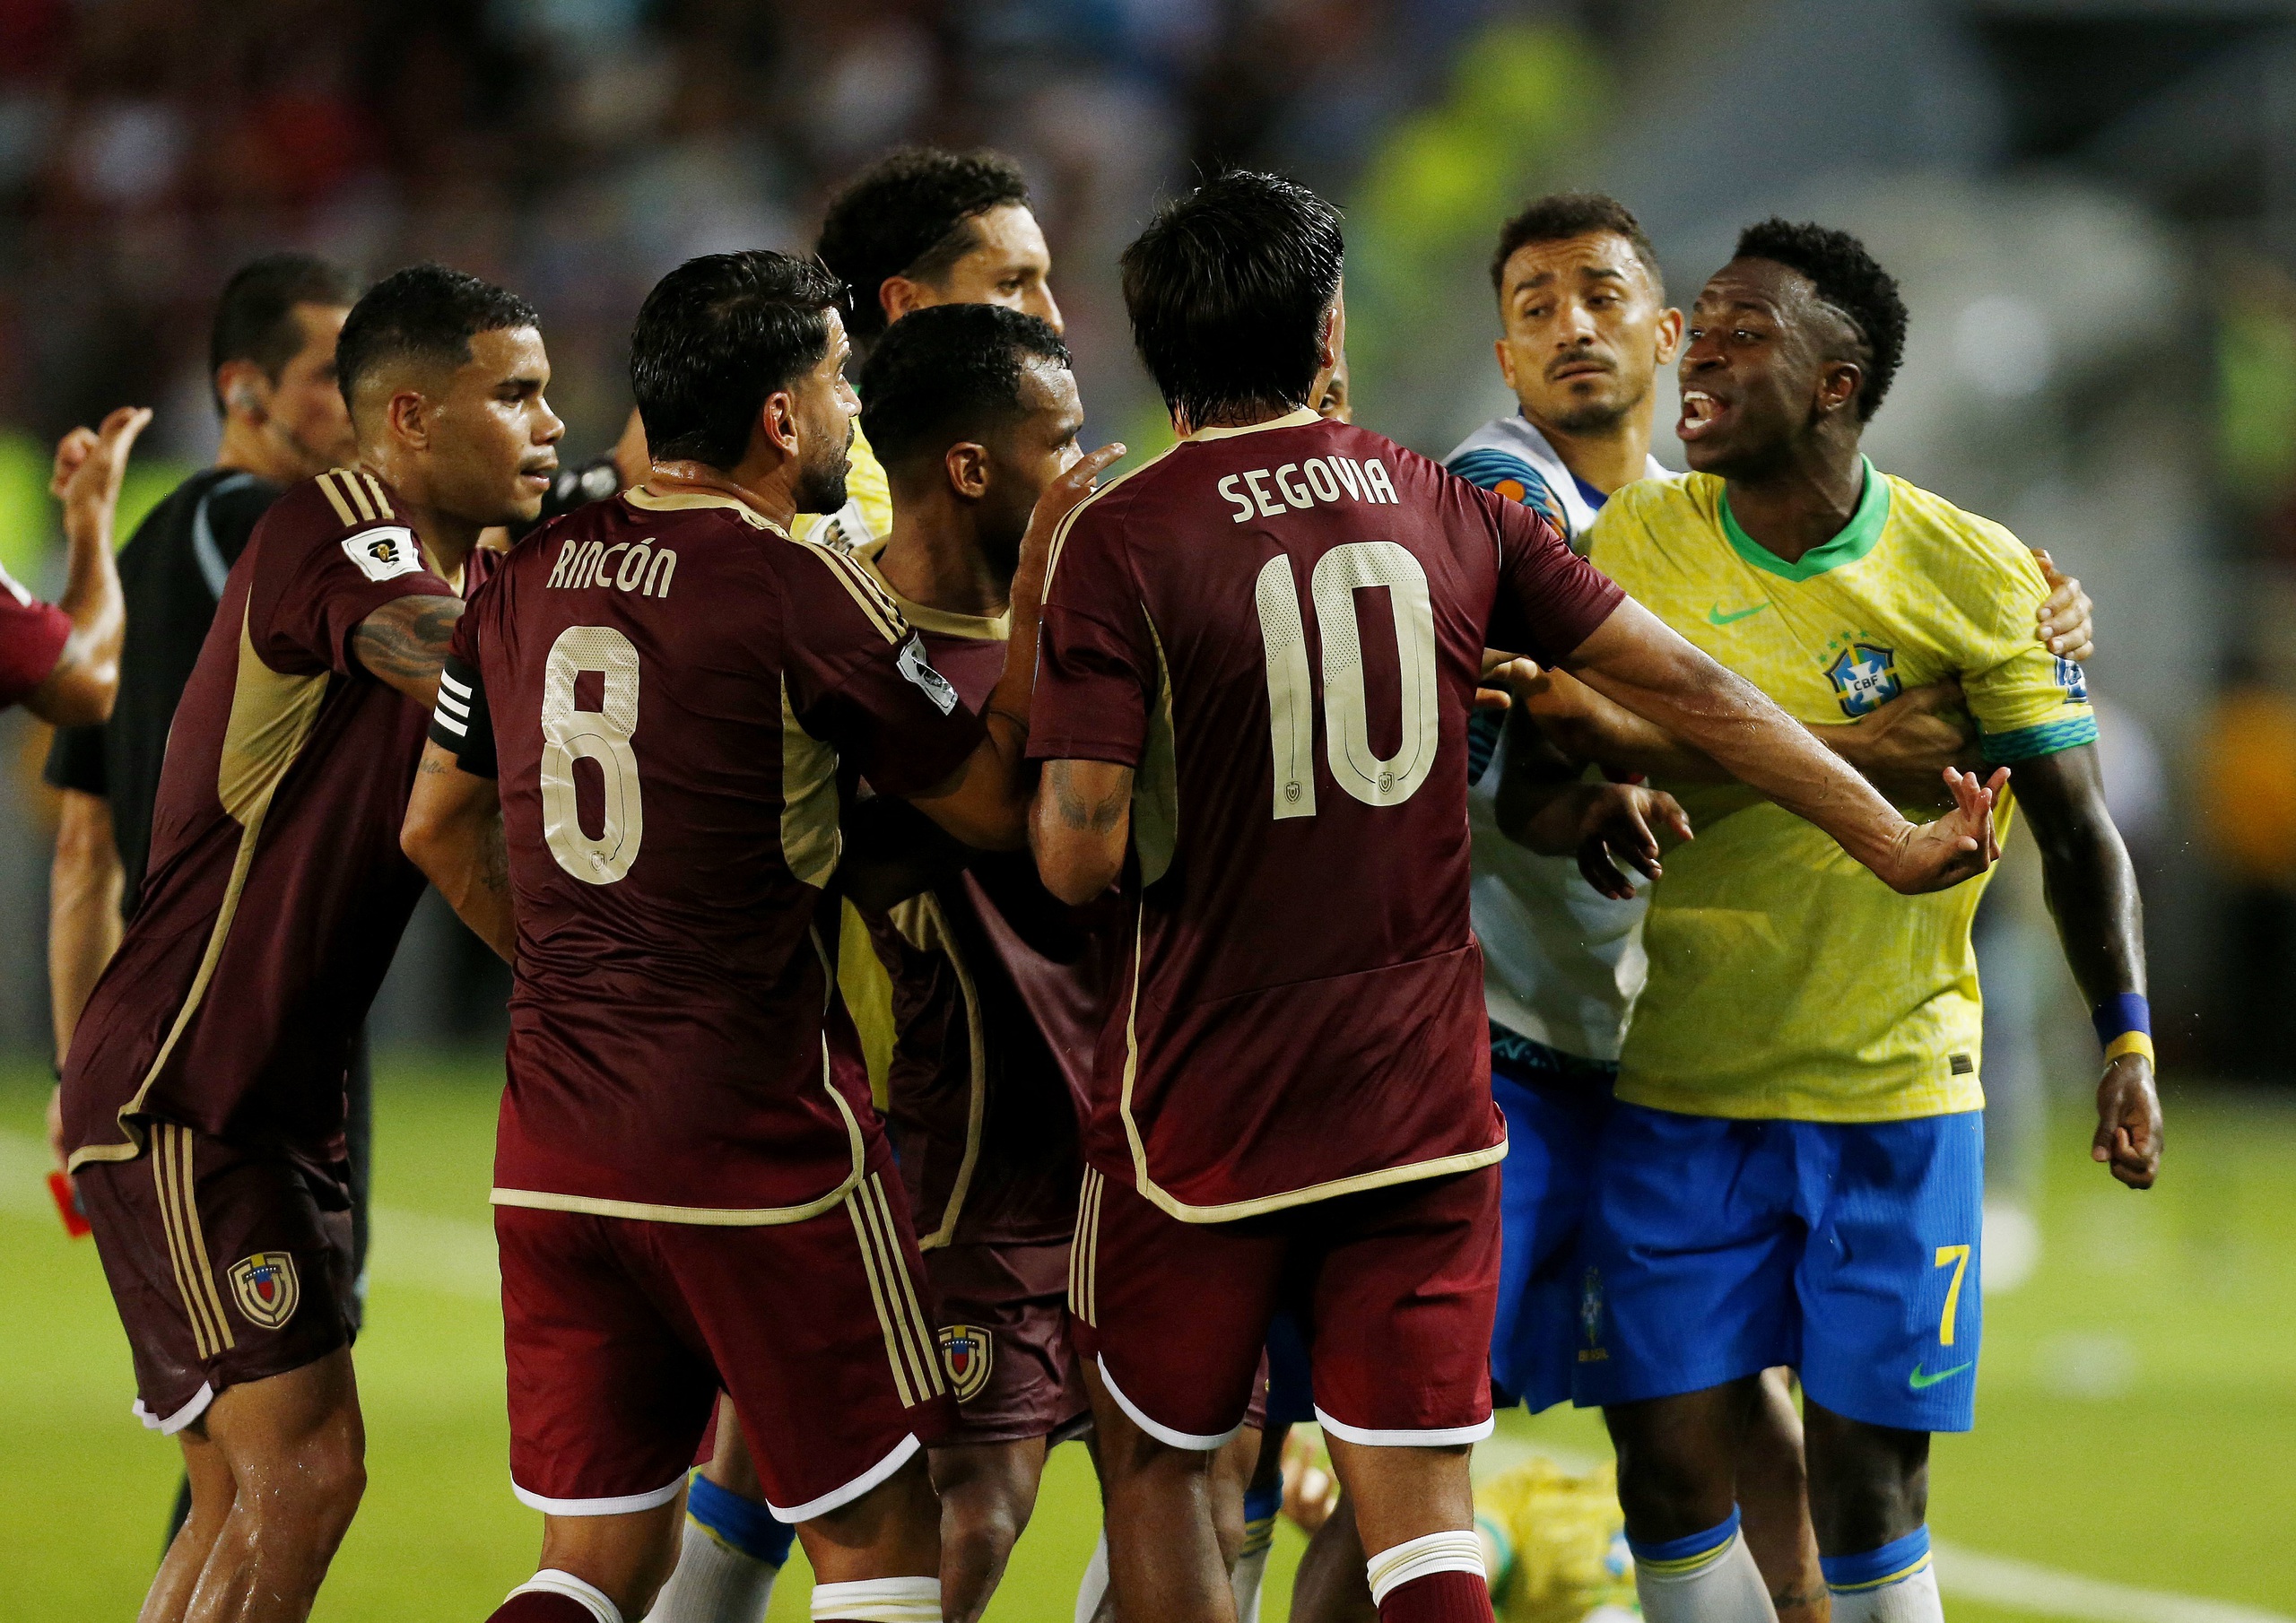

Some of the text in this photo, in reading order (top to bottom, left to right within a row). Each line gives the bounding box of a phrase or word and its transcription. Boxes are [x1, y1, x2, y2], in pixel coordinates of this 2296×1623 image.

[1217, 456, 1400, 524] SEGOVIA
[545, 537, 677, 598] RINCÓN
[1256, 541, 1439, 820] 10
[1853, 674, 1878, 691] CBF
[541, 625, 643, 885] 8
[1935, 1244, 1970, 1345] 7
